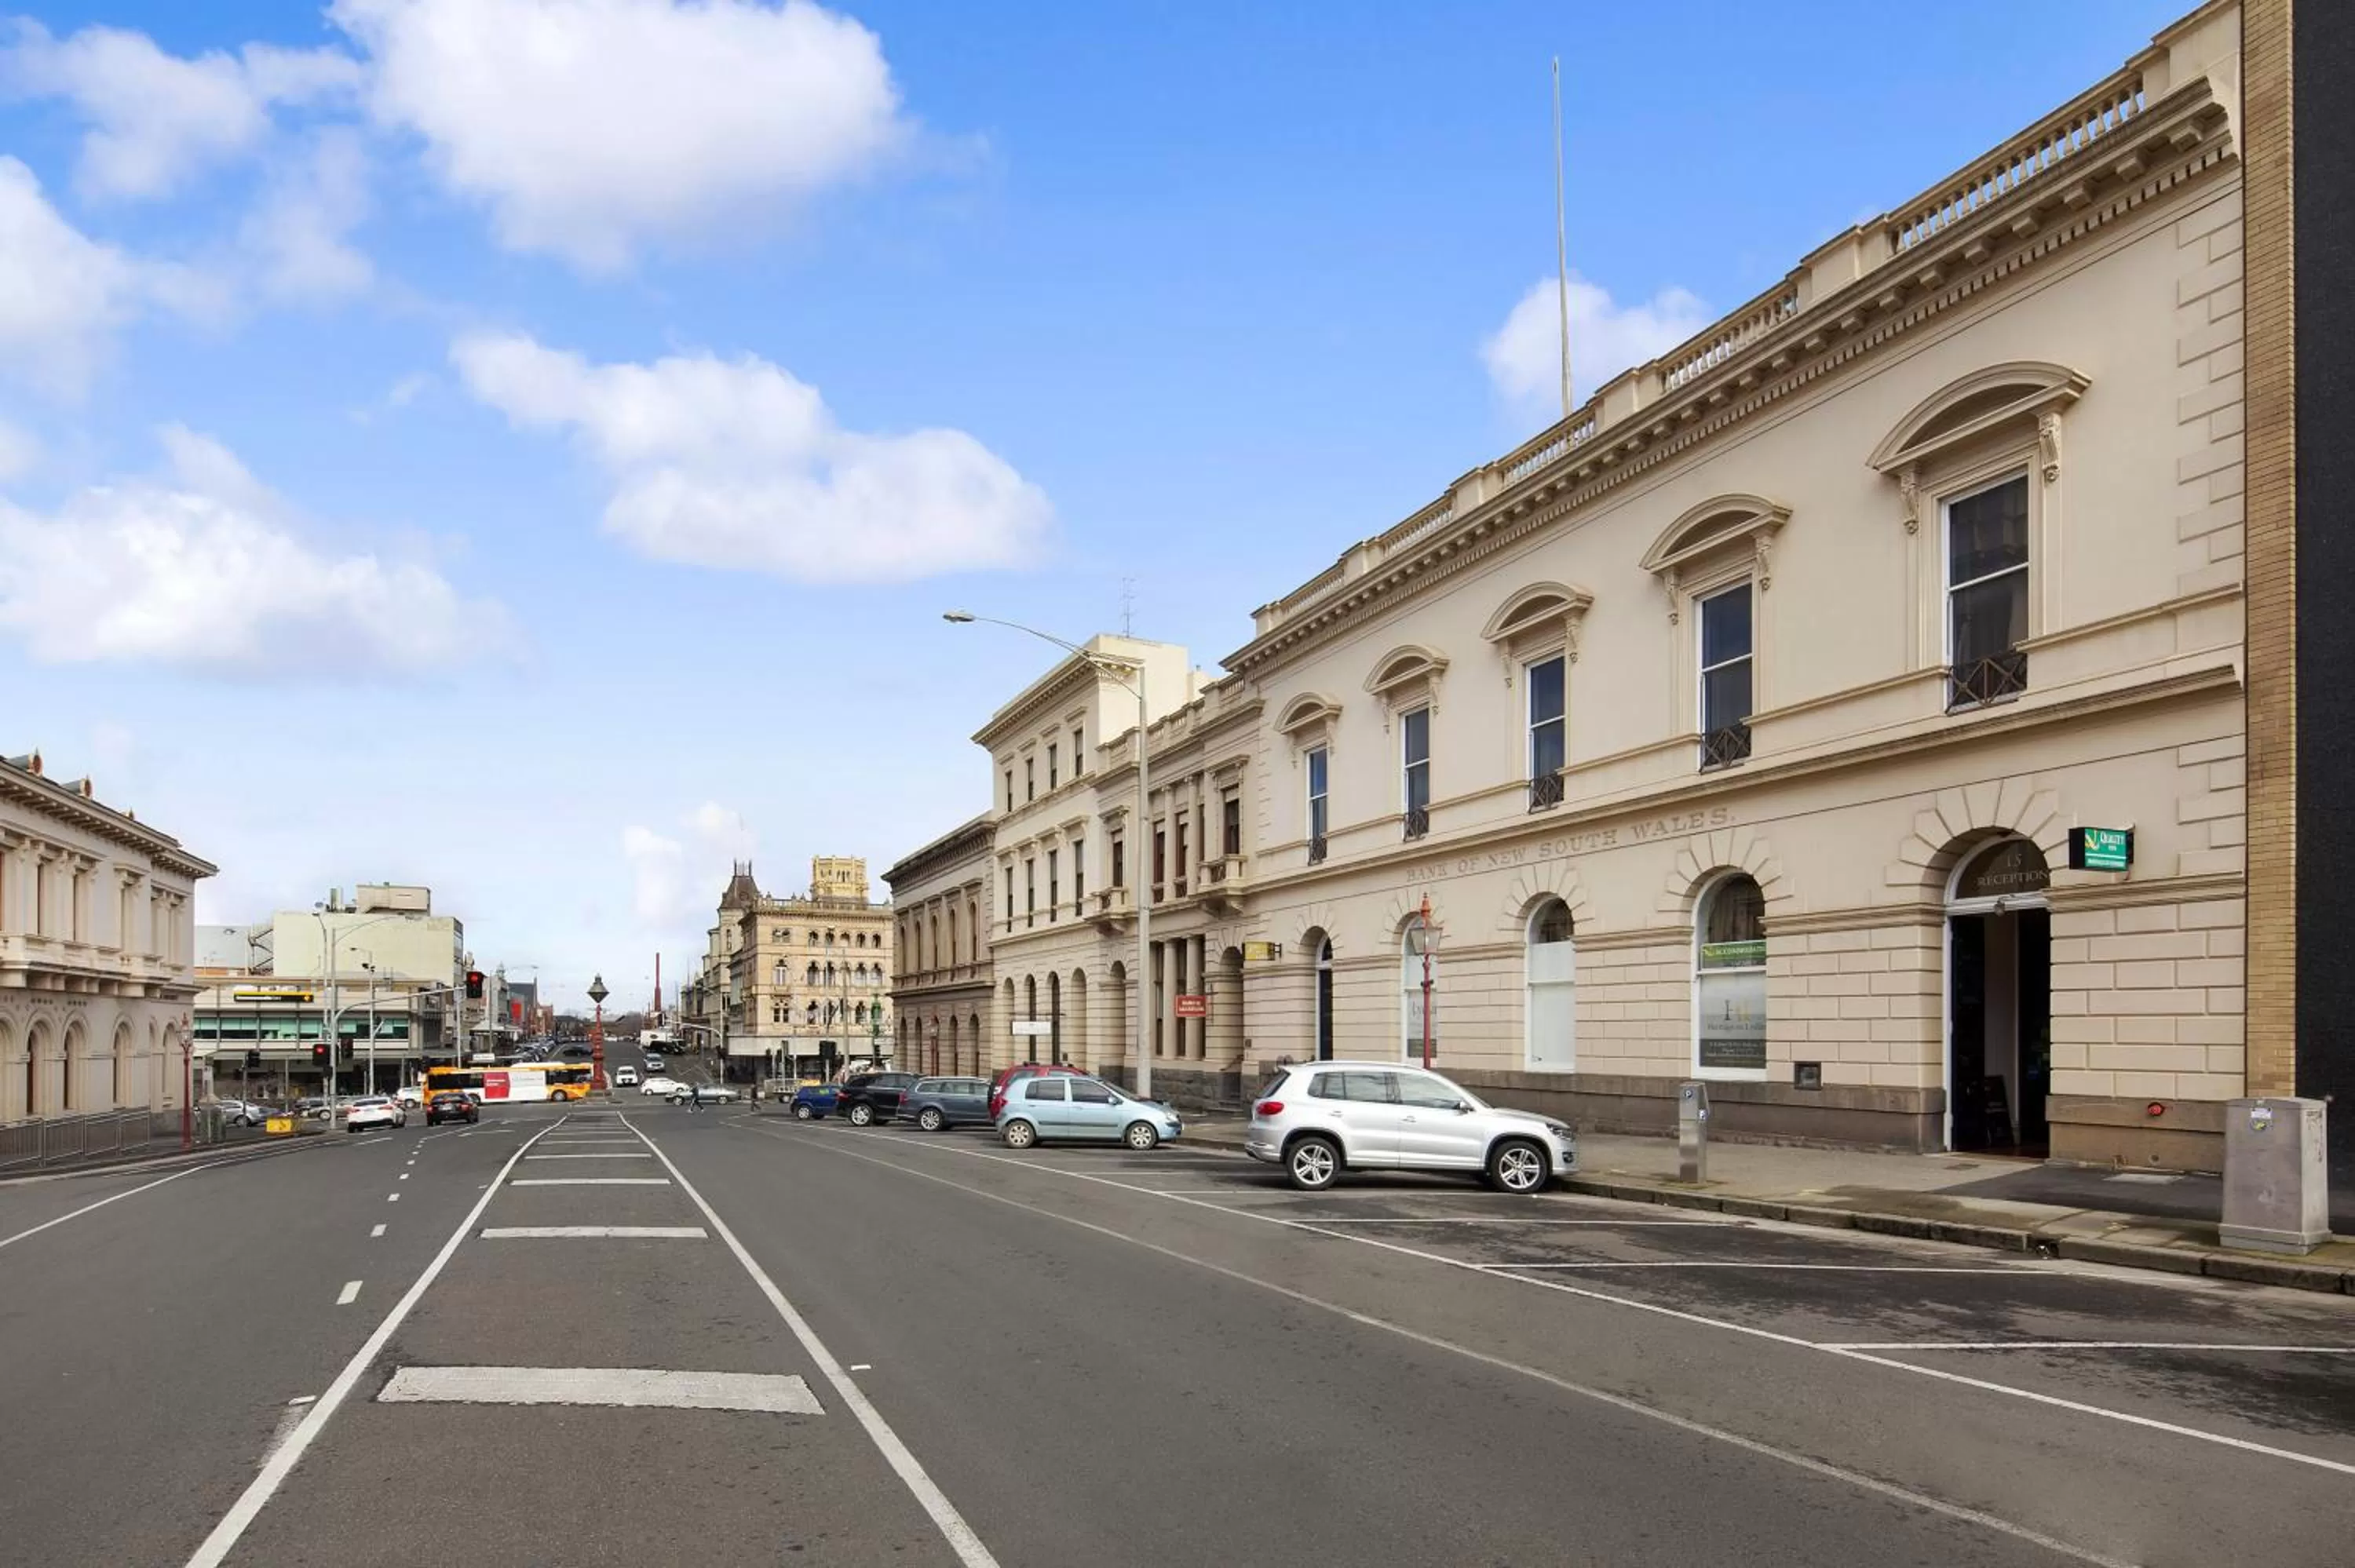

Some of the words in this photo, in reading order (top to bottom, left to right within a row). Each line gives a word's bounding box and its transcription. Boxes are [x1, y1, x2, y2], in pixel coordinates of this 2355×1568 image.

[1407, 864, 1448, 882] BANK
[1458, 856, 1480, 873] OF
[1488, 846, 1527, 866] NEW
[1539, 829, 1618, 857] SOUTH
[1977, 870, 2048, 887] RECEPTION
